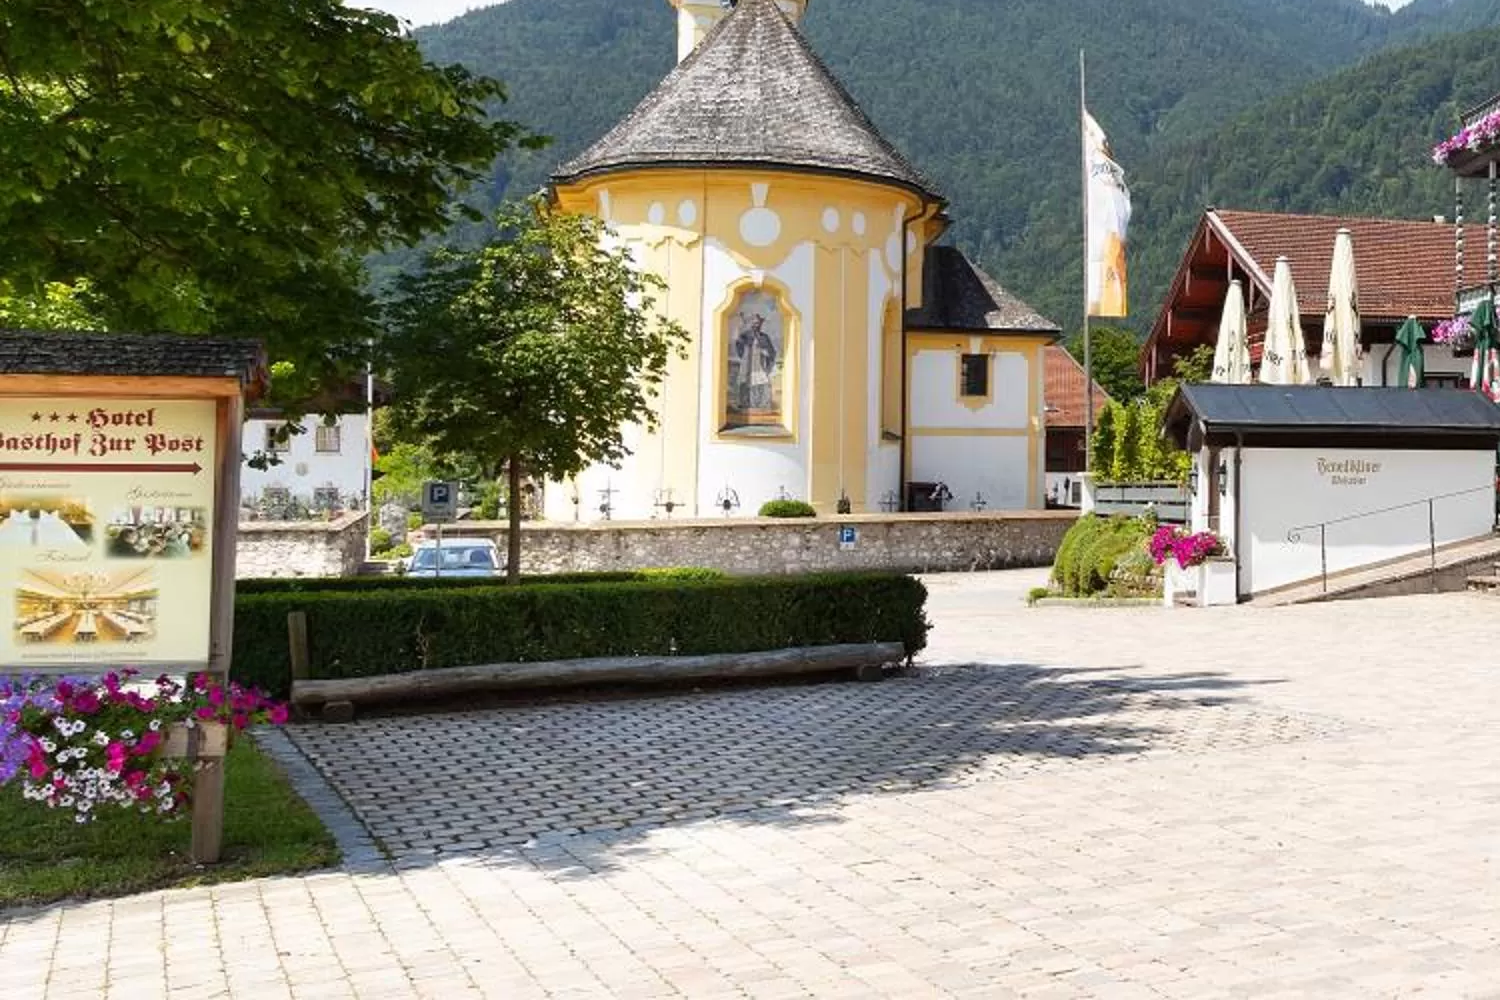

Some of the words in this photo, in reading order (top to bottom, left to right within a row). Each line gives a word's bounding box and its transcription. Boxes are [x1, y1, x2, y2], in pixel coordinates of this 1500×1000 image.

[86, 407, 156, 428] Hotel
[89, 433, 136, 457] Zur
[145, 433, 204, 455] Post
[433, 486, 447, 501] P
